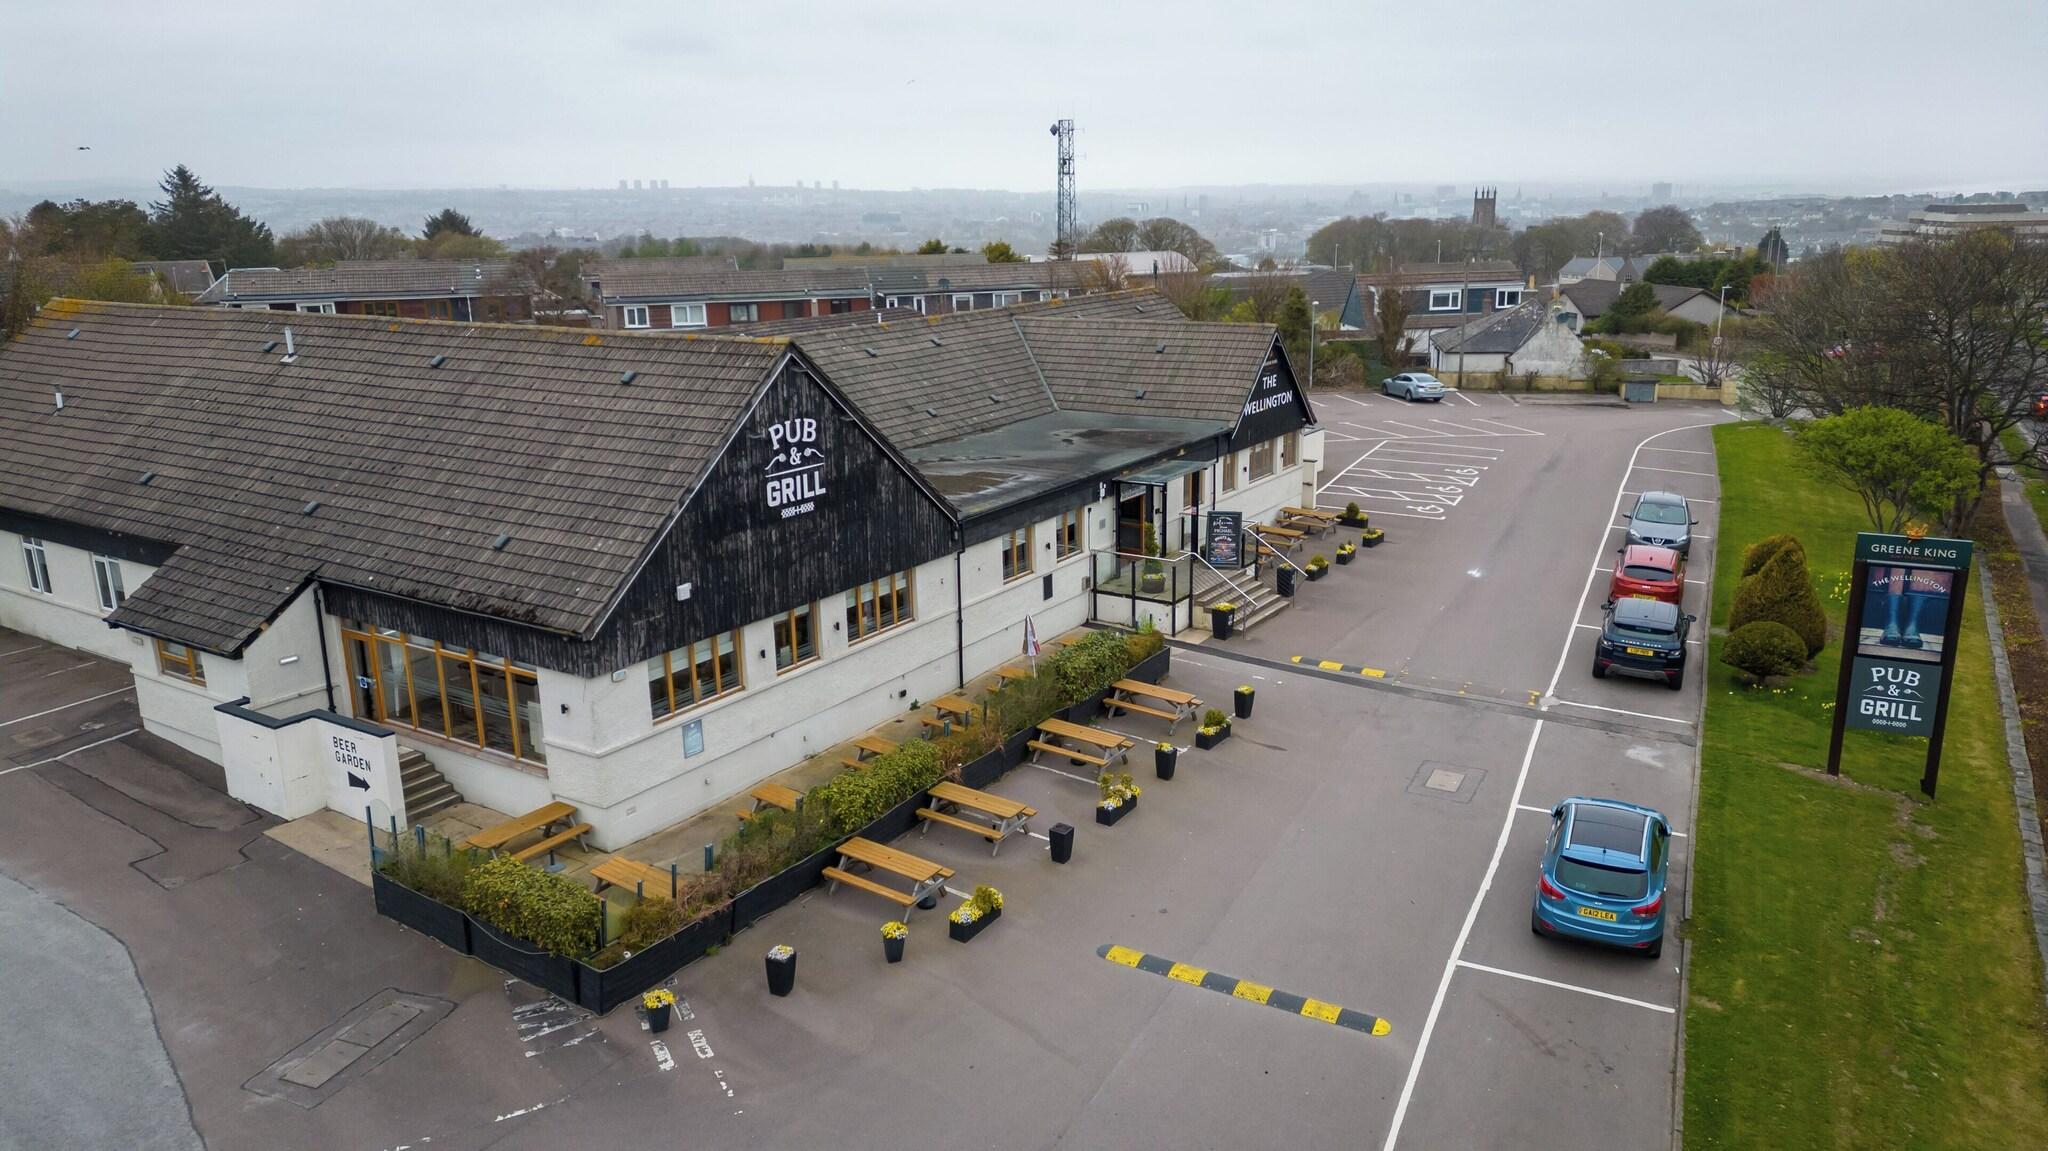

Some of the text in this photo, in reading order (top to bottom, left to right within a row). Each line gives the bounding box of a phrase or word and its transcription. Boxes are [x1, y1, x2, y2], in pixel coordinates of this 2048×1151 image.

[1262, 374, 1277, 390] THE
[1244, 390, 1293, 416] WELLINGTON
[768, 418, 817, 450] PUB
[789, 447, 802, 465] &
[766, 471, 826, 508] GRILL
[1871, 544, 1920, 556] GREENE
[1924, 548, 1957, 559] KING
[1872, 575, 1946, 593] THE WELLINGTON
[1870, 667, 1921, 686] PUB
[1888, 684, 1901, 696] &
[1860, 699, 1922, 721] GRILL
[332, 736, 357, 753] BEER
[335, 750, 372, 772] GARDEN
